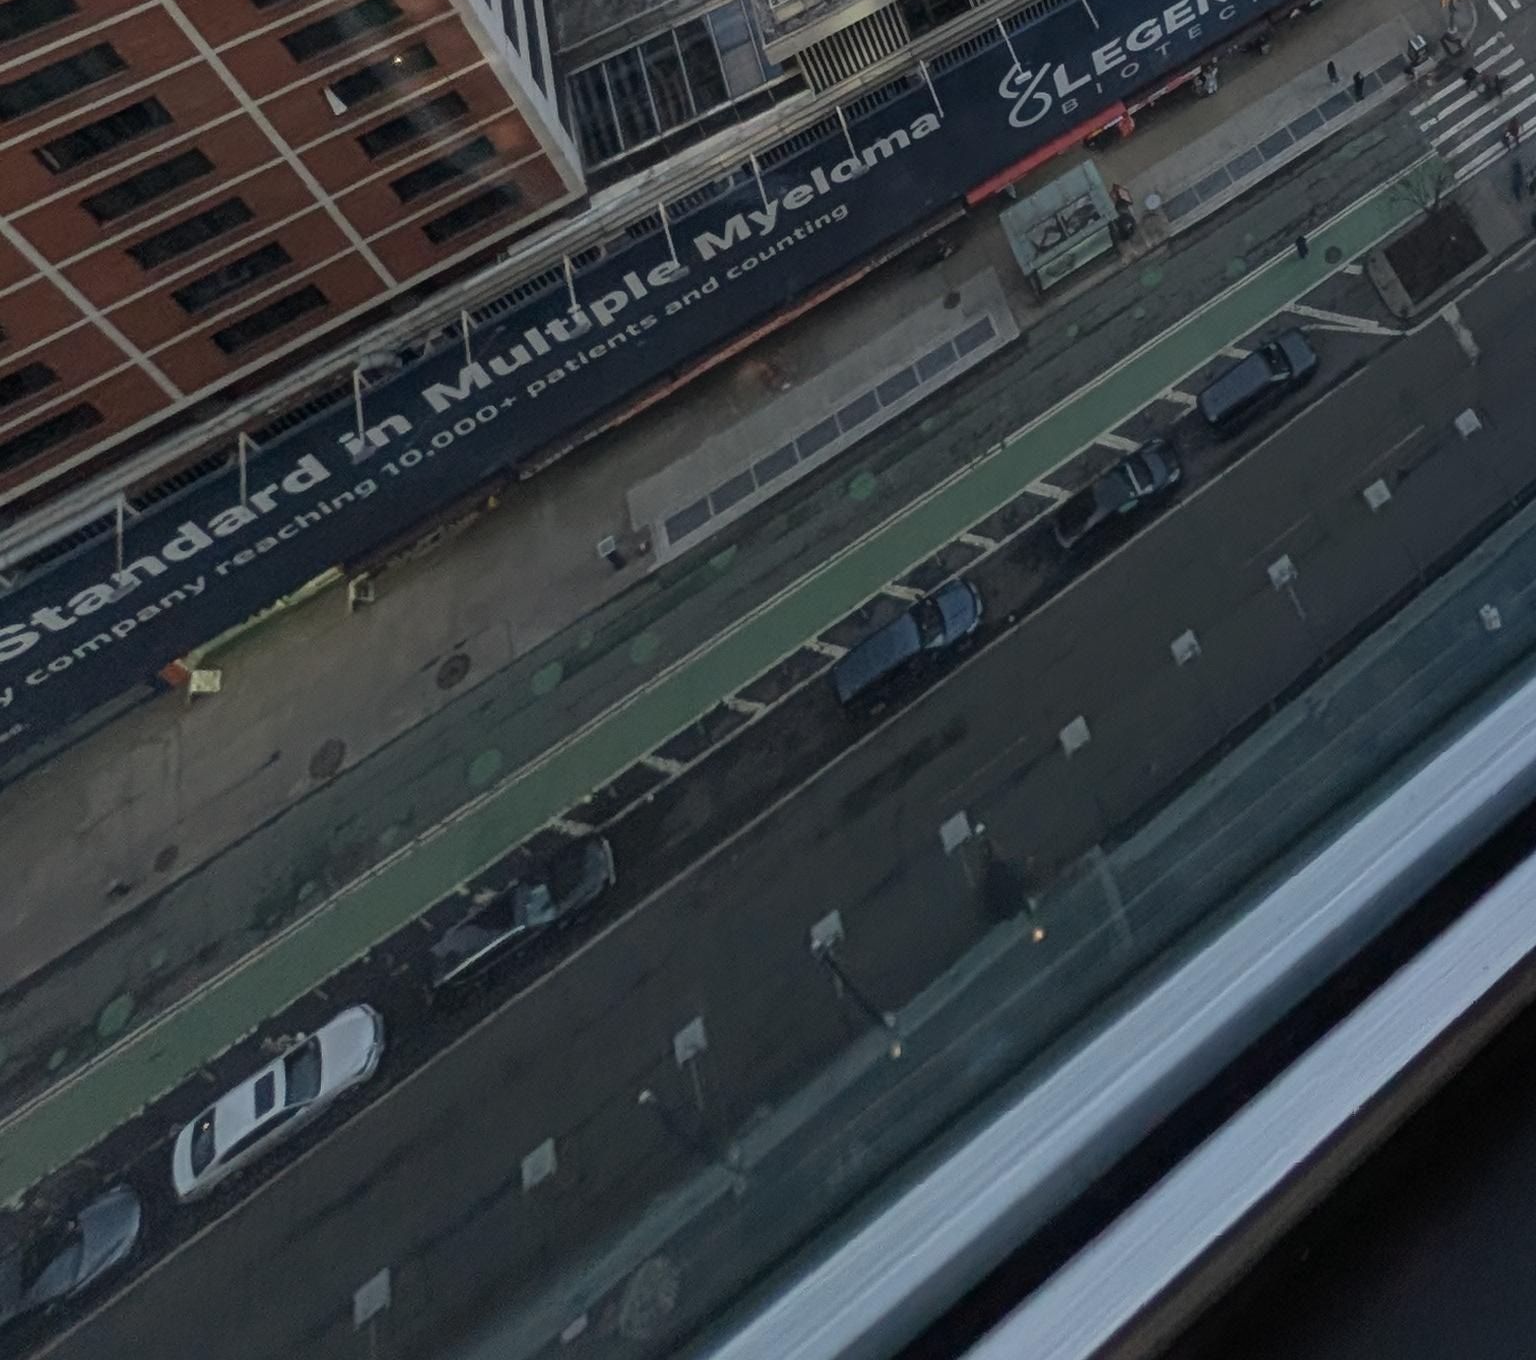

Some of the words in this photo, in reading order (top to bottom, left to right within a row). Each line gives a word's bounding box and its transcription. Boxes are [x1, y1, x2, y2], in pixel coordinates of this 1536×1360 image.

[0, 453, 331, 664] Standard
[338, 413, 413, 460] in
[421, 259, 681, 414] Multiple
[693, 112, 942, 262] Myeloma
[25, 575, 206, 686] company
[215, 478, 378, 576] reaching
[527, 312, 659, 398] patients
[664, 276, 720, 318] and
[726, 202, 849, 280] counting
